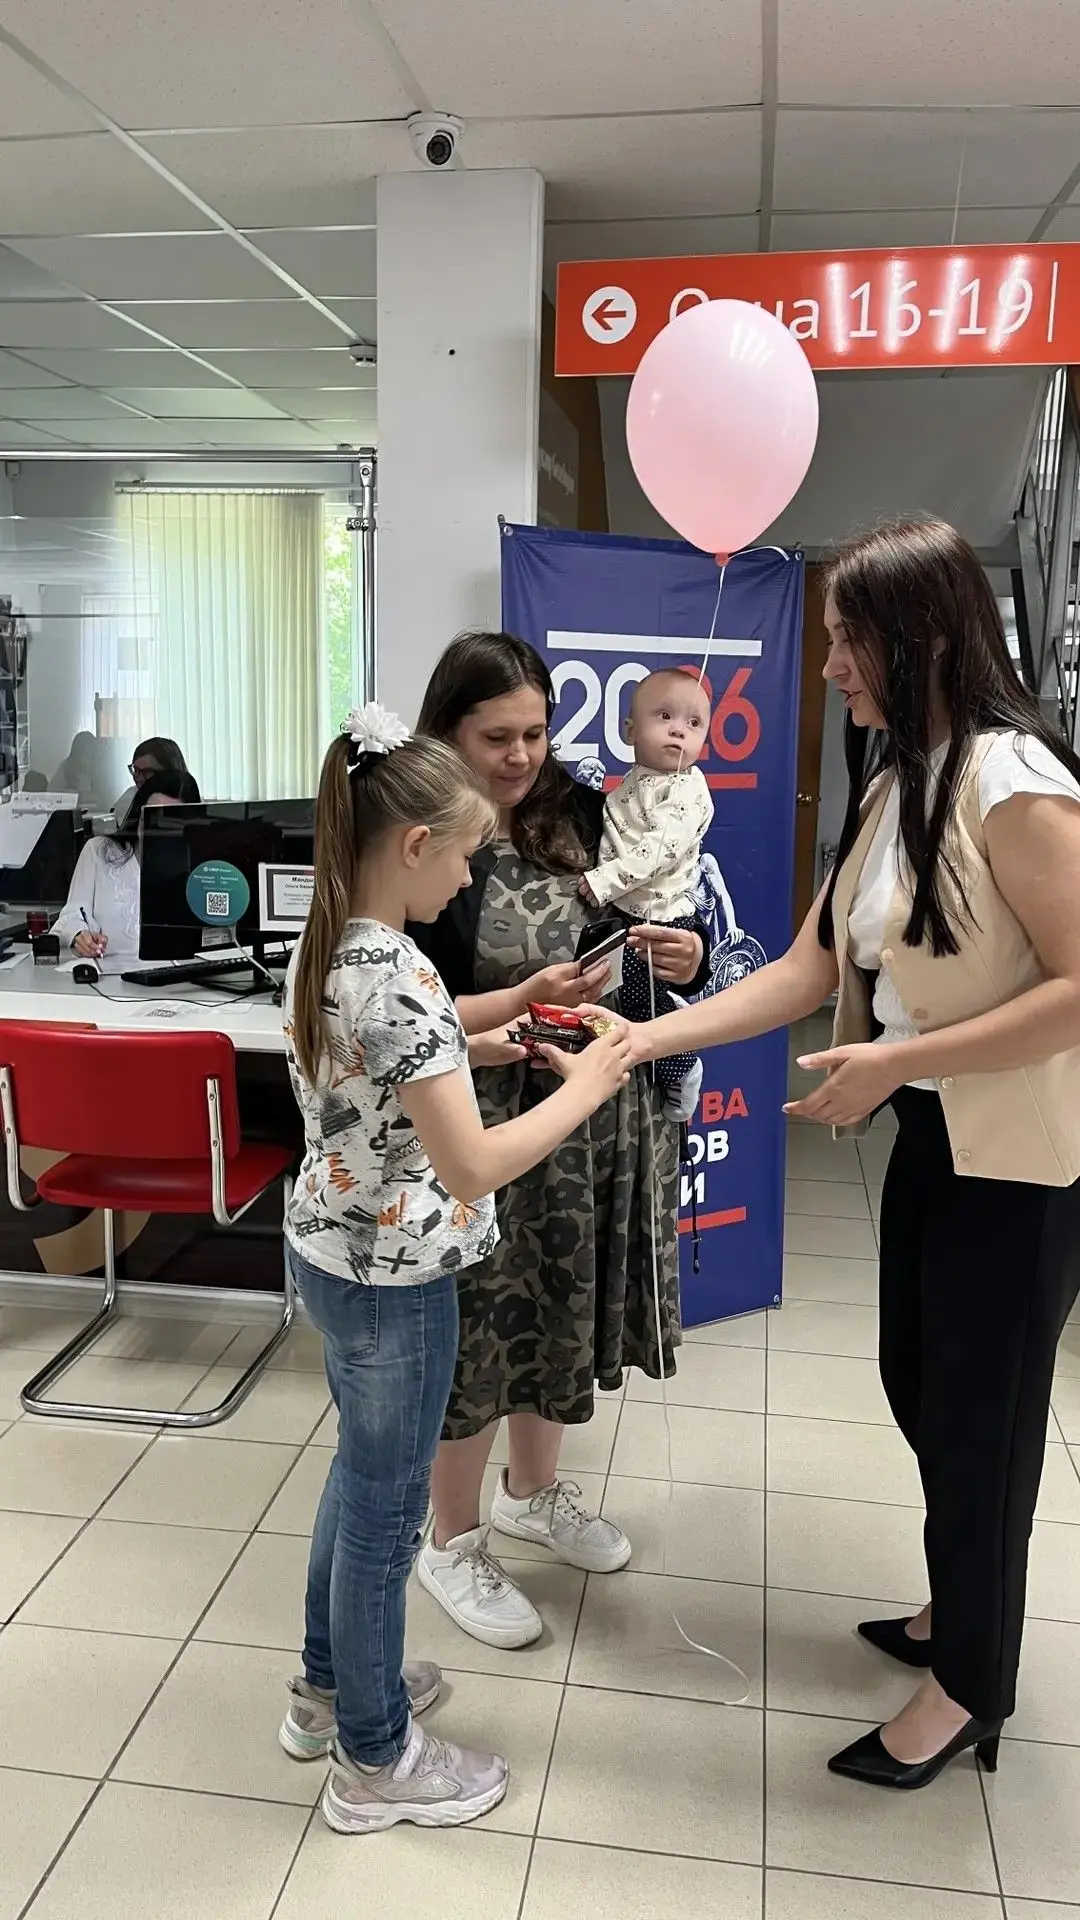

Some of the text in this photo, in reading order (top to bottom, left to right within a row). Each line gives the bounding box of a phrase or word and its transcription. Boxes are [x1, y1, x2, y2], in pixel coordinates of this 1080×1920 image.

[669, 276, 1033, 340] Оа 16-19
[548, 659, 762, 764] 206
[687, 1087, 749, 1126] ВА
[687, 1129, 730, 1167] ОВ
[680, 1171, 705, 1207] И
